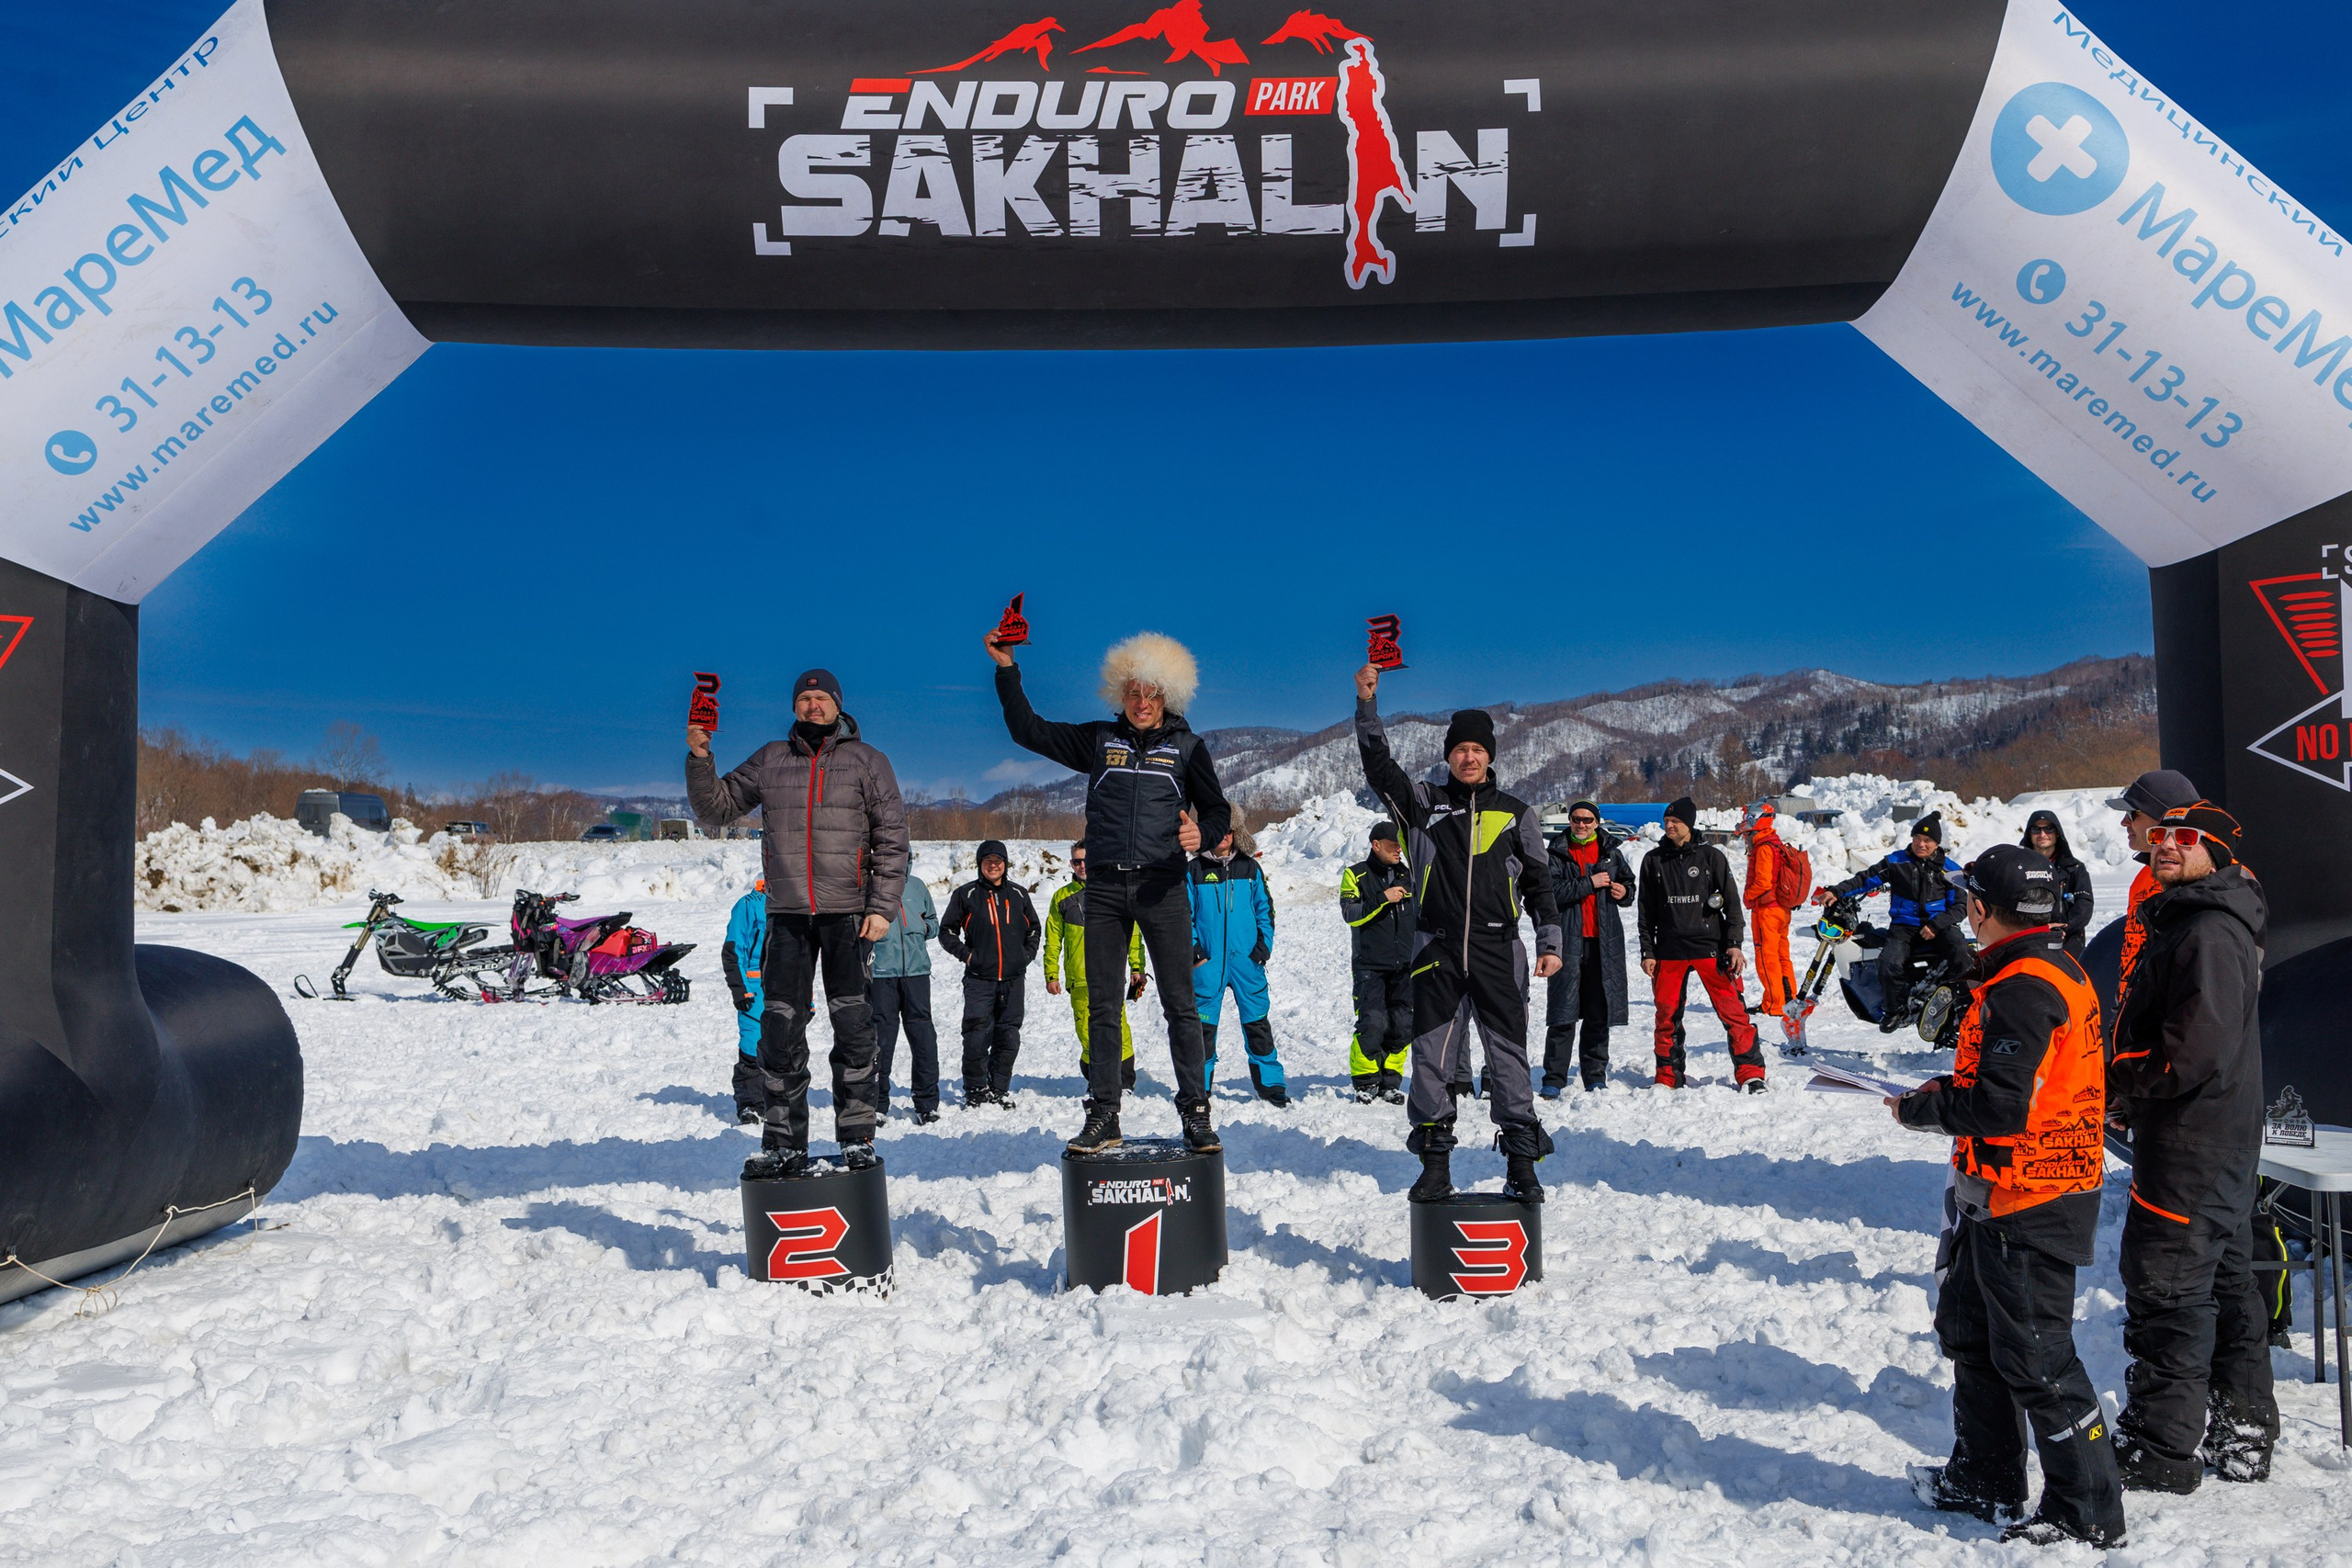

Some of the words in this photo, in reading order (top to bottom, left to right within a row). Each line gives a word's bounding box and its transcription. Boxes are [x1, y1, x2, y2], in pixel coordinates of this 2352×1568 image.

[92, 36, 220, 151] Центр
[839, 77, 1237, 130] ENDURO
[1253, 80, 1321, 112] PARK
[2052, 10, 2344, 257] Медицинский
[777, 127, 1509, 237] SAKHALIN
[0, 114, 288, 378] МареМед
[2116, 180, 2352, 430] МареМ
[95, 276, 274, 434] 31-13-13
[1951, 280, 2217, 503] www.maremed.ru
[2064, 299, 2244, 449] 31-13-13
[68, 299, 340, 534] www.maremed.ru
[691, 714, 716, 723] SPORT
[2297, 723, 2340, 761] NO
[1105, 754, 1128, 766] 131
[2025, 1164, 2095, 1179] SAKHALIN
[2050, 1129, 2088, 1137] ENDURO
[1091, 1184, 1188, 1203] SAKHALIN
[1098, 1179, 1151, 1189] ENDURO
[764, 1205, 853, 1280] 2
[1123, 1208, 1163, 1295] 1
[1448, 1220, 1529, 1294] 3
